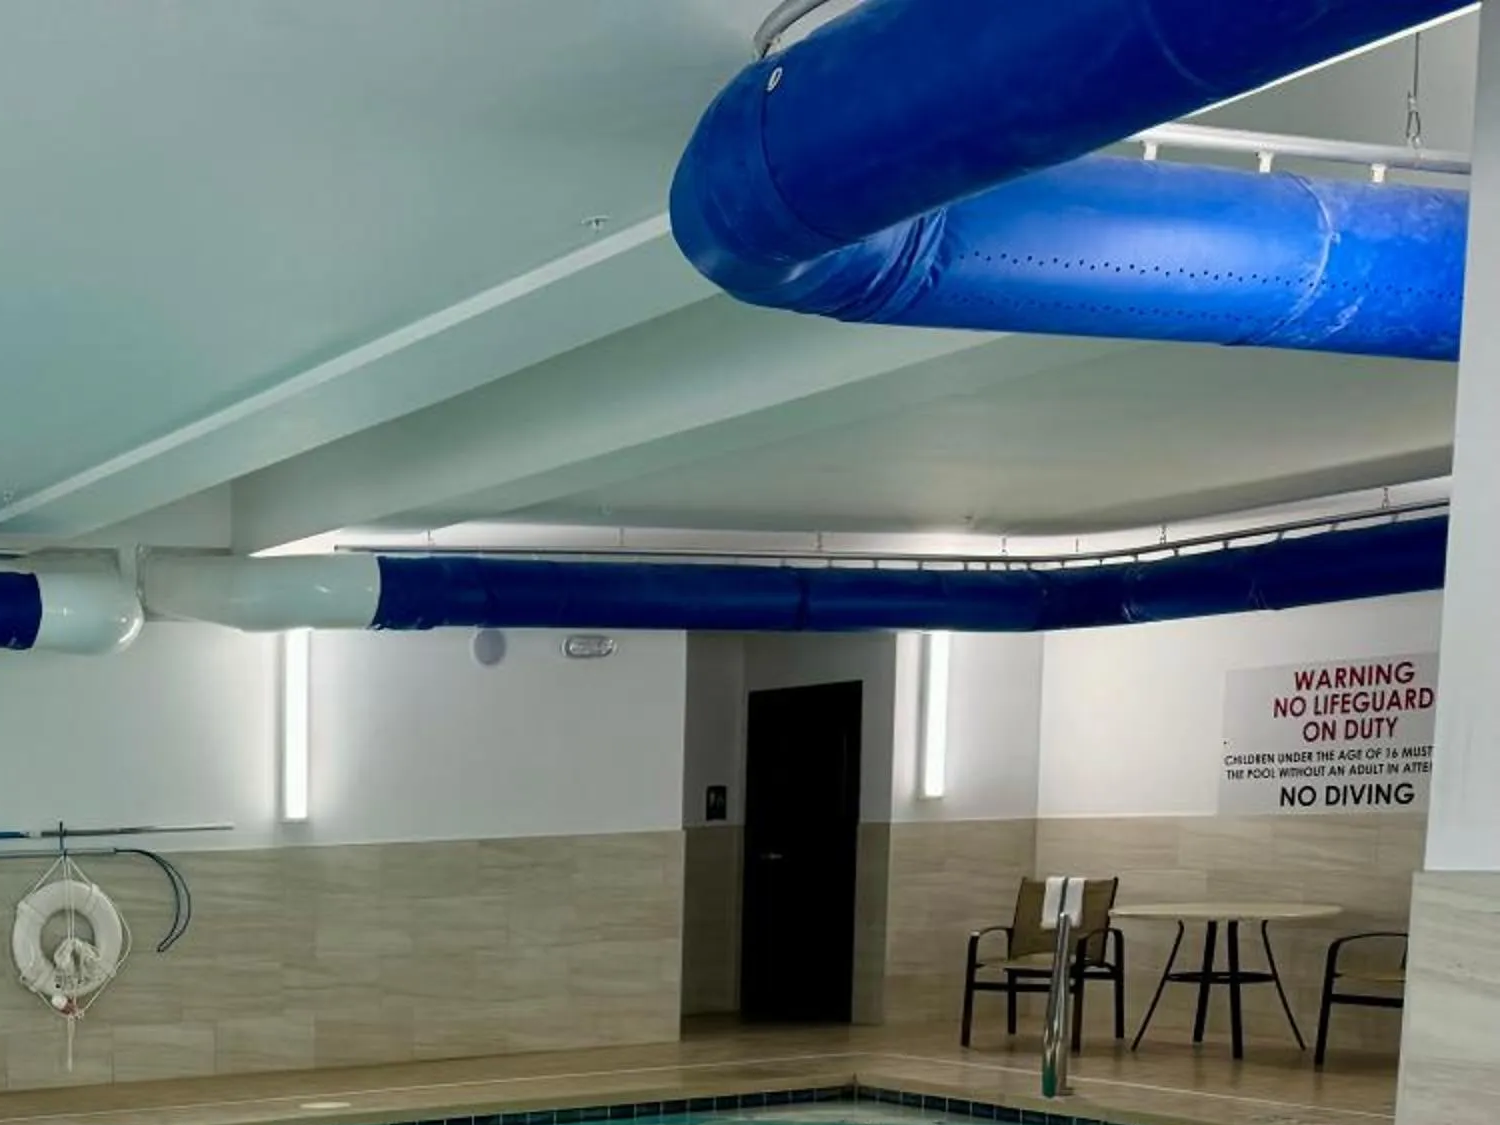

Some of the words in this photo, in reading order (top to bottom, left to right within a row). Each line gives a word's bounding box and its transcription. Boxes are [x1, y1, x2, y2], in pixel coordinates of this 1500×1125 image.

[1294, 661, 1415, 691] WARNING
[1273, 696, 1307, 718] NO
[1313, 687, 1434, 716] LIFEGUARD
[1303, 720, 1336, 742] ON
[1344, 716, 1398, 740] DUTY
[1224, 753, 1275, 766] CHILDREN
[1278, 751, 1313, 763] UNDER
[1316, 750, 1334, 762] THE
[1337, 749, 1362, 761] AGE
[1365, 748, 1382, 760] OF
[1385, 747, 1398, 759] 16
[1401, 746, 1434, 758] MUST
[1226, 769, 1244, 780] THE
[1247, 768, 1275, 780] POOL
[1279, 766, 1325, 778] WITHOUT
[1327, 765, 1346, 777] AN
[1349, 763, 1384, 776] ADULT
[1387, 763, 1399, 774] IN
[1280, 785, 1317, 807] NO
[1325, 782, 1415, 806] DIVING
